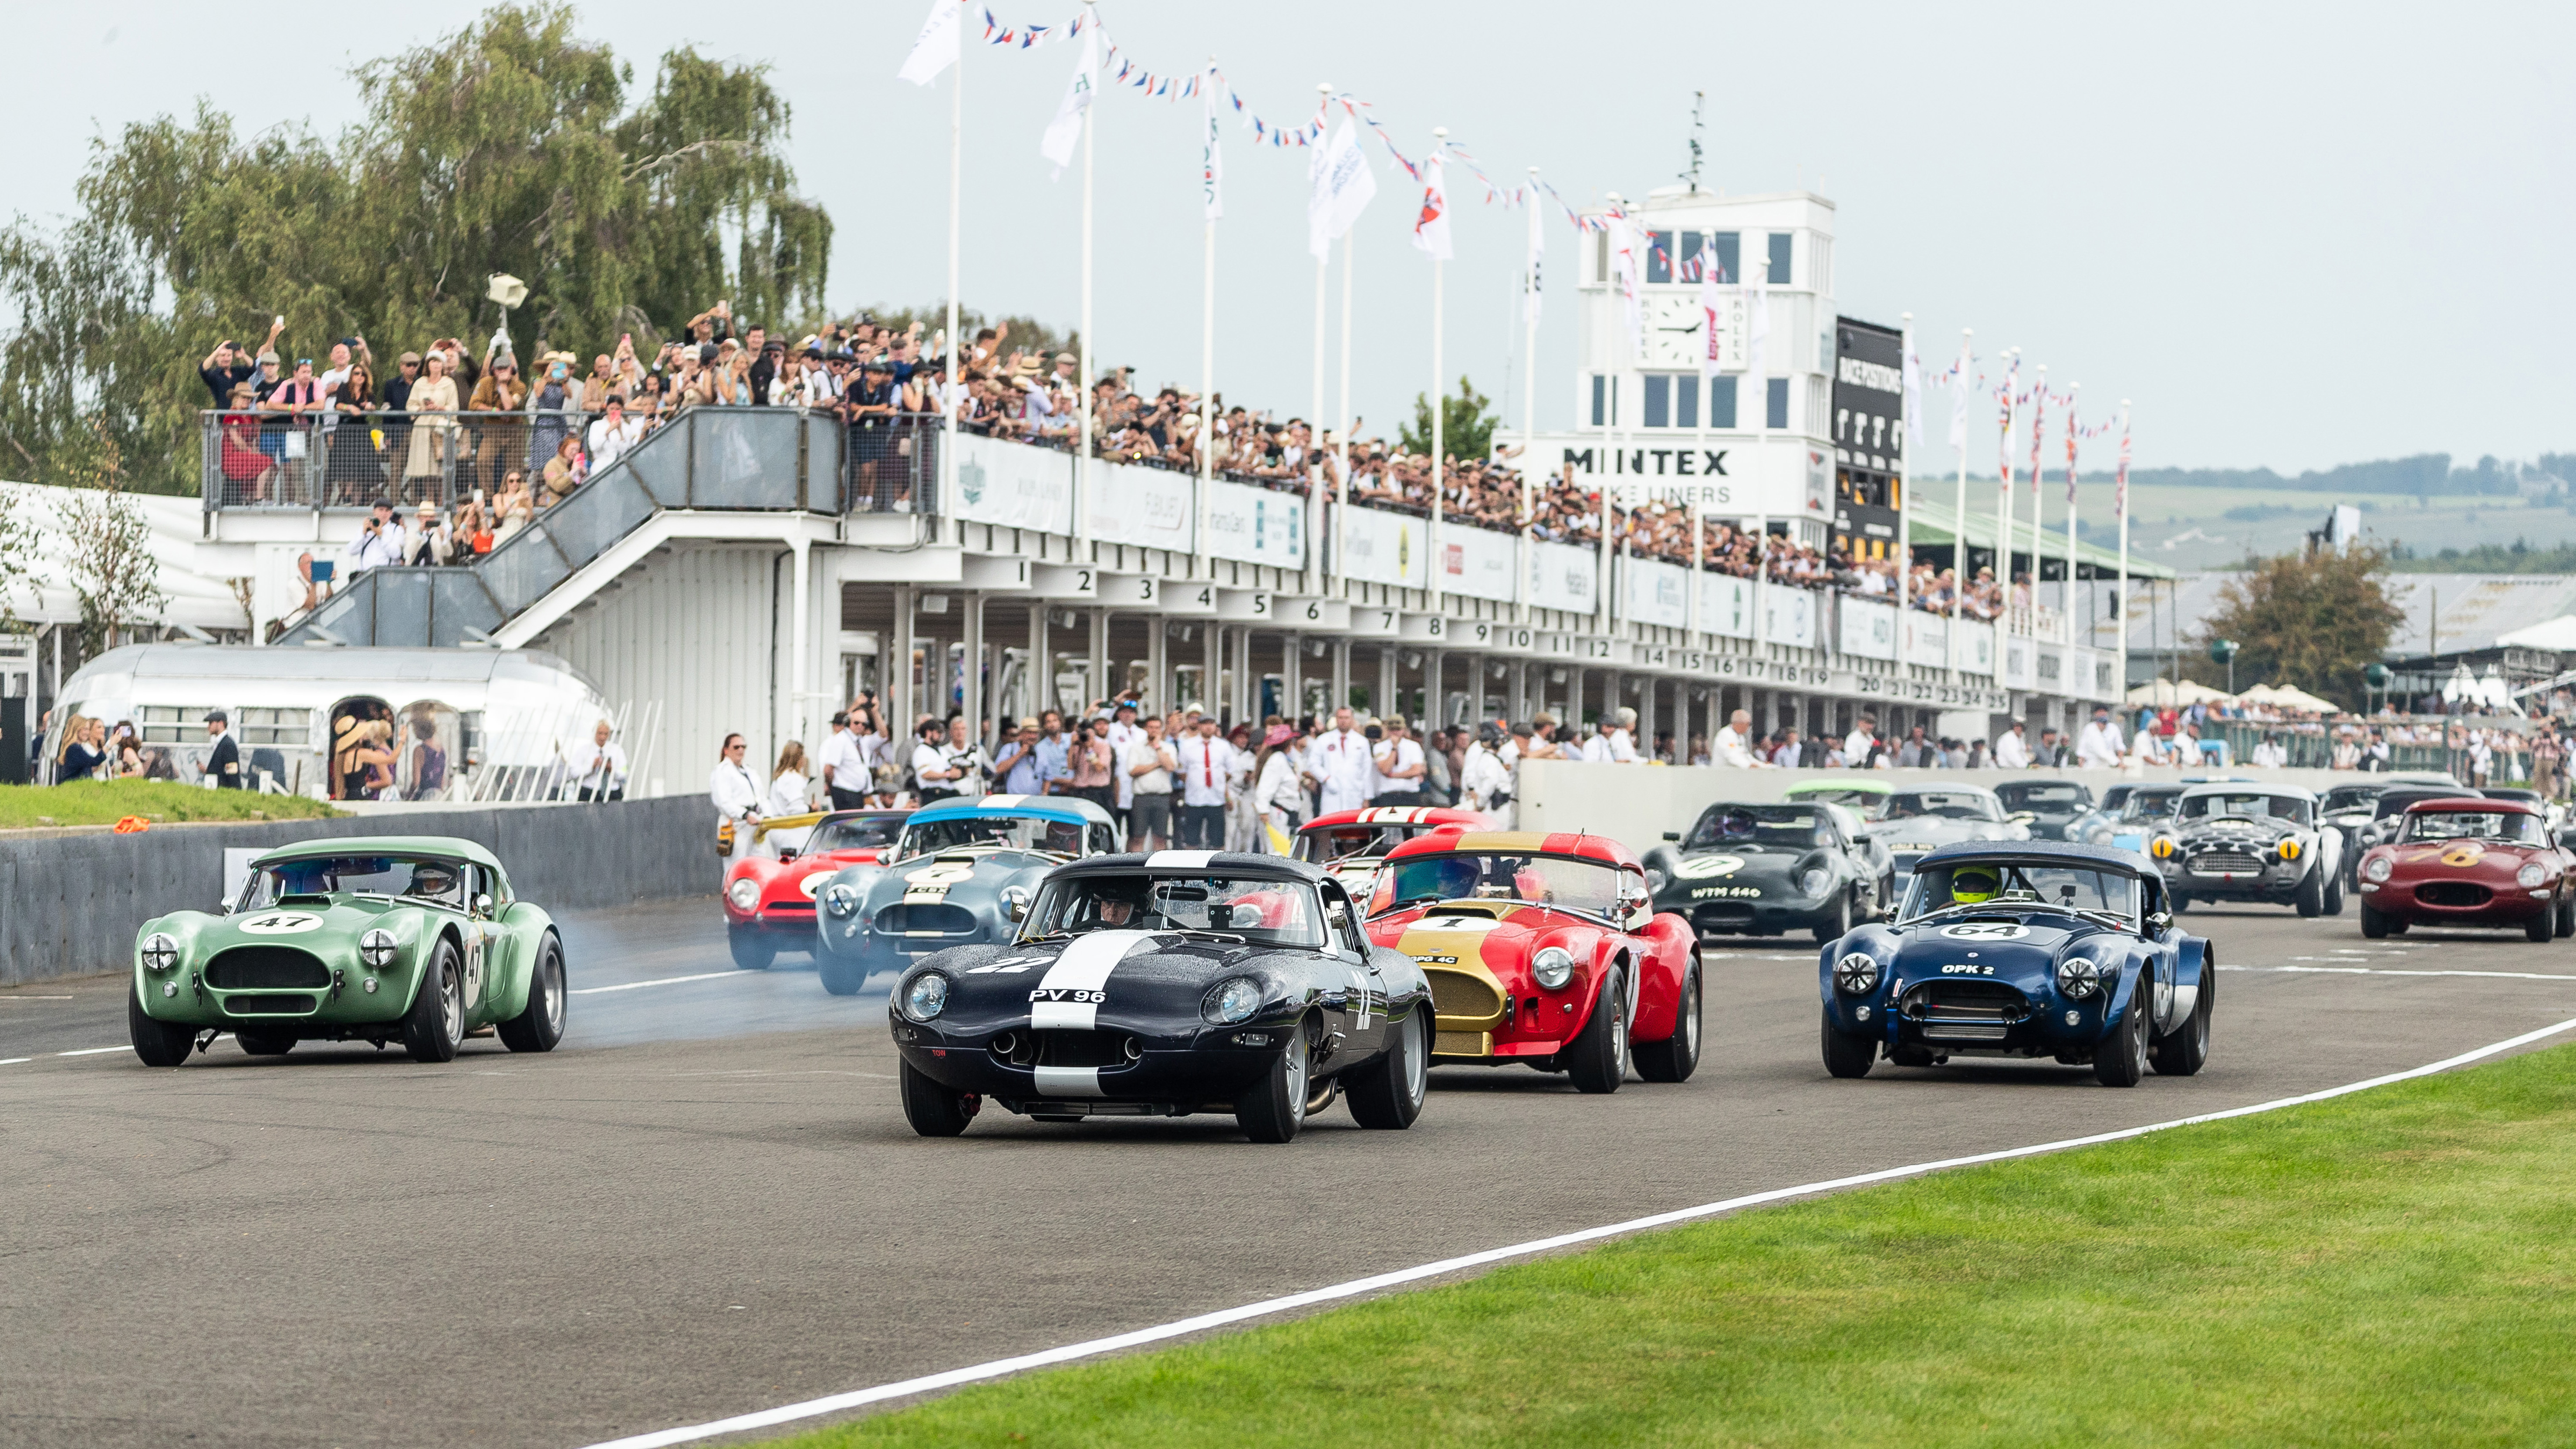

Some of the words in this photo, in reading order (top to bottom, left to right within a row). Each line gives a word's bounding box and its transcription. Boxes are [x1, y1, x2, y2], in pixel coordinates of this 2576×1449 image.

[1020, 562, 1024, 581] 1
[1078, 571, 1090, 590] 2
[1140, 580, 1152, 599] 3
[1198, 588, 1210, 606] 4
[1255, 595, 1265, 613] 5
[1307, 603, 1318, 619] 6
[1383, 612, 1393, 629] 7
[1430, 618, 1441, 635] 8
[1477, 625, 1487, 641] 9
[1509, 630, 1529, 647] 10
[1553, 636, 1570, 652] 11
[1590, 641, 1609, 657] 12
[1645, 649, 1663, 663] 14
[1683, 654, 1700, 669] 15
[1715, 658, 1733, 673] 16
[1747, 661, 1764, 676] 17
[1779, 666, 1797, 681] 18
[1810, 671, 1827, 685] 19
[1861, 677, 1880, 691] 20
[1892, 681, 1907, 696] 21
[1912, 685, 1931, 698] 22
[1940, 688, 1959, 703] 23
[1962, 691, 1981, 705] 24
[1989, 695, 2005, 708] 25
[1688, 859, 1732, 871] 17
[931, 870, 959, 878] 7
[1691, 887, 1728, 898] WTM
[251, 917, 313, 927] 47
[1437, 918, 1465, 928] 1
[1948, 925, 2019, 937] 64
[468, 945, 481, 985] 47
[966, 956, 1057, 973] 22
[1941, 964, 1979, 974] OPK
[1983, 966, 1994, 975] 2
[1028, 990, 1068, 1002] PV
[1074, 990, 1106, 1003] 96
[1350, 970, 1371, 1030] 22
